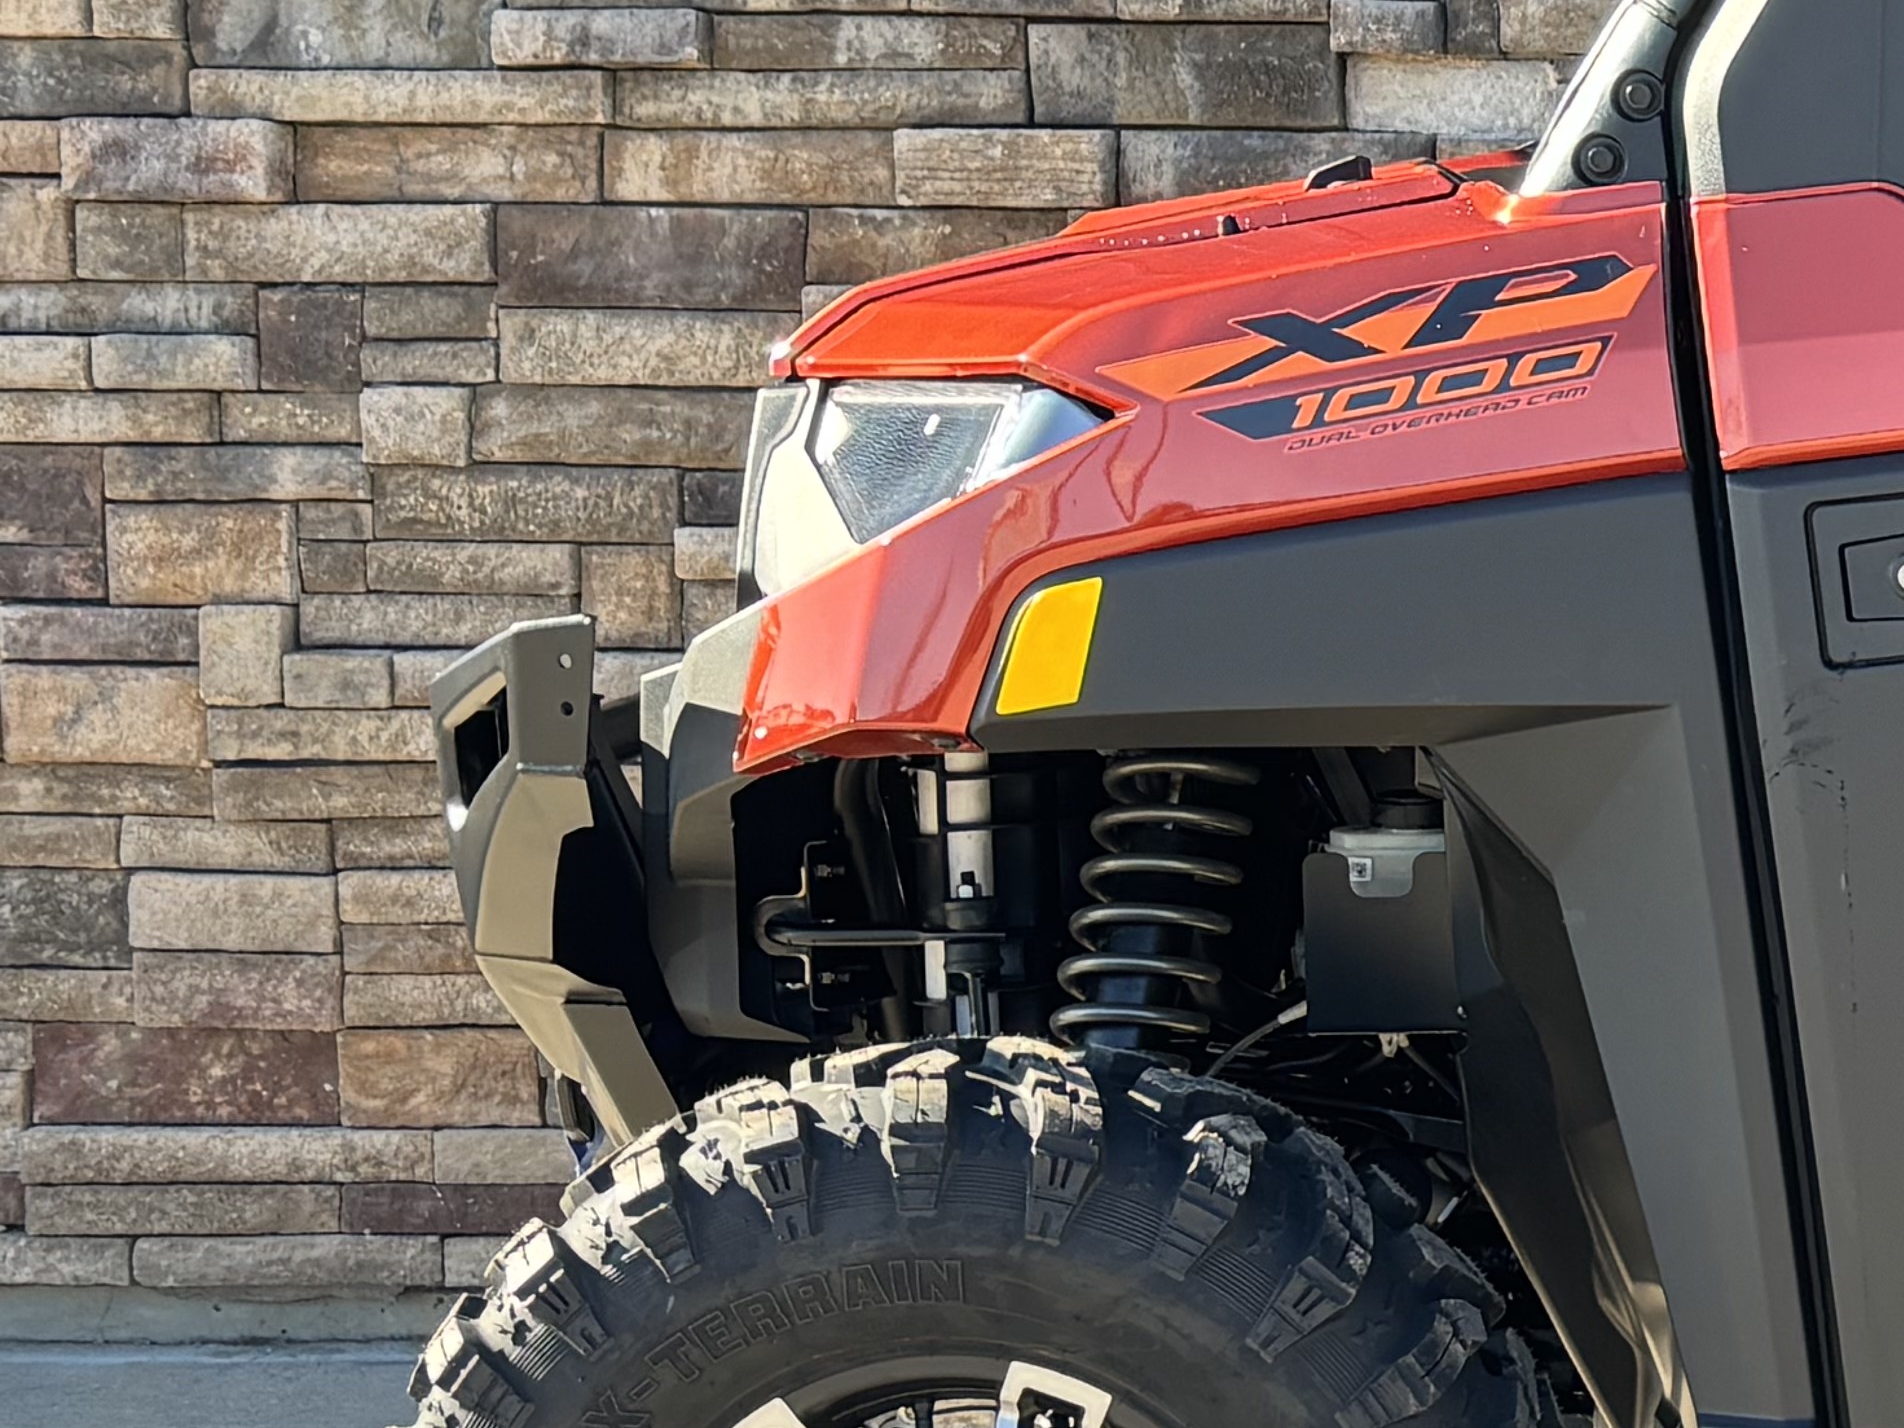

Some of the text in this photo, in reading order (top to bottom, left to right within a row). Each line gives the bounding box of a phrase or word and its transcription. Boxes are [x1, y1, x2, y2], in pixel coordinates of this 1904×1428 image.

[1175, 252, 1636, 394] XP
[1287, 385, 1588, 452] DUAL OVERHEAD CAM
[1291, 340, 1604, 429] 1000
